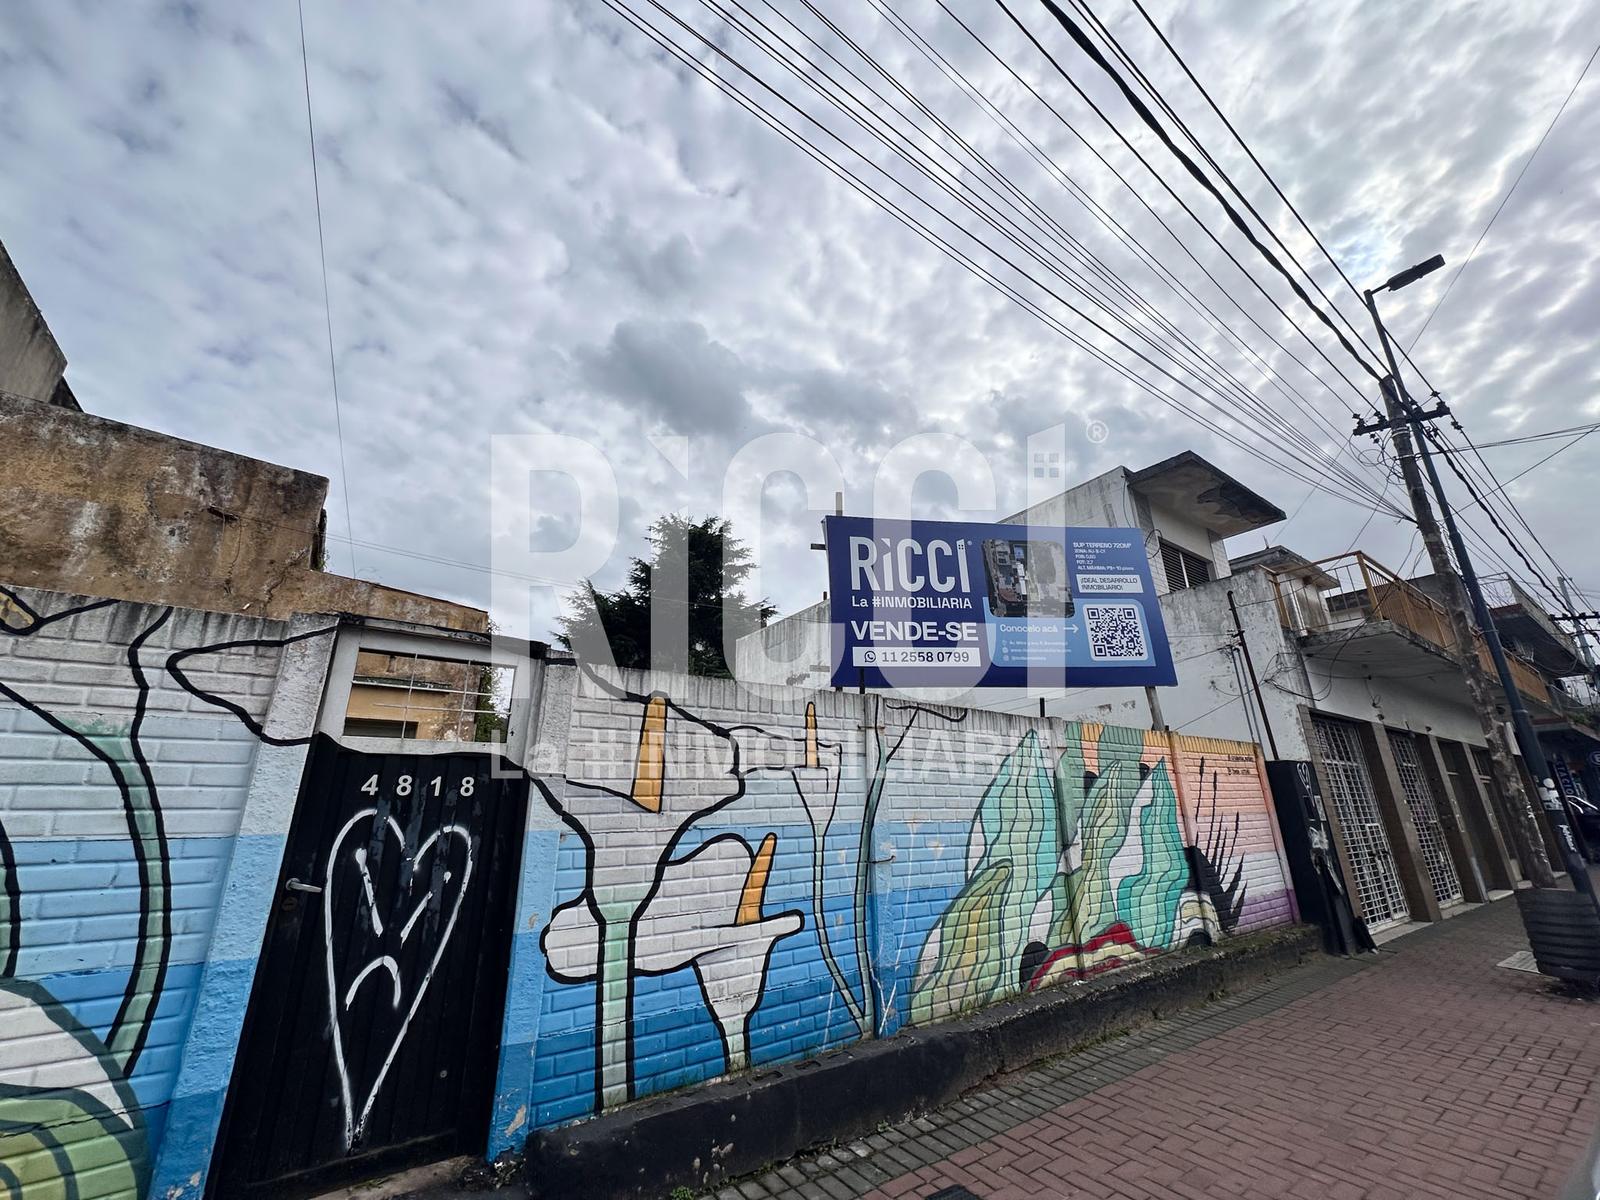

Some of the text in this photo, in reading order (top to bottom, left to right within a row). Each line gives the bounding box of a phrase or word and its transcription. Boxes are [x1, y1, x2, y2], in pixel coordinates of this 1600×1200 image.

[851, 595, 973, 609] La #INMOBILIARIA
[850, 620, 980, 642] VENDE-SE
[882, 651, 970, 663] 11 2558 0799
[360, 774, 475, 797] 4818
